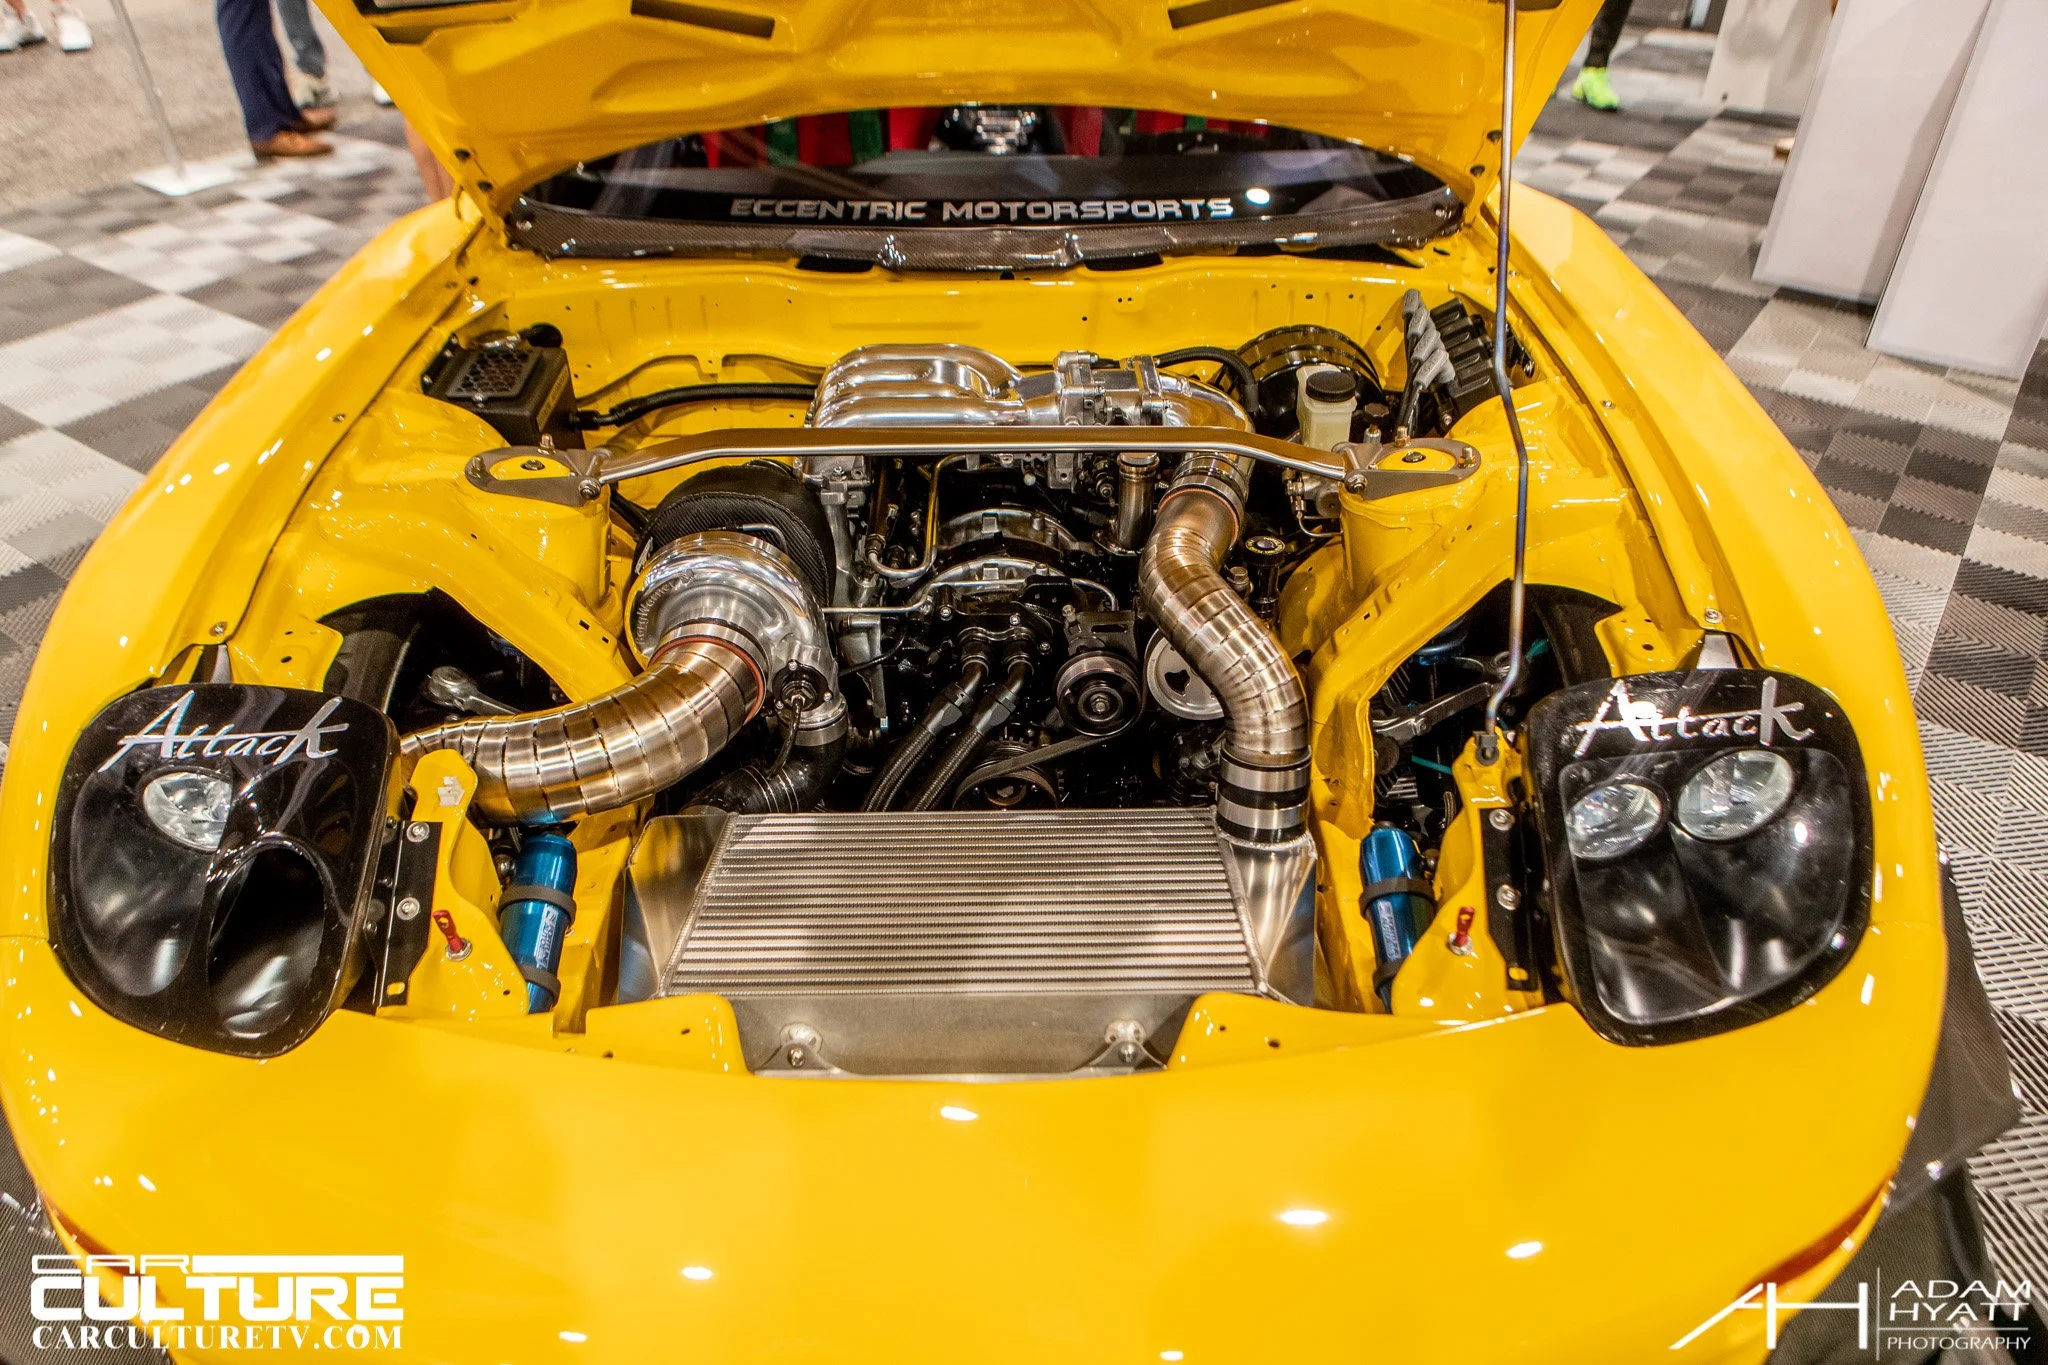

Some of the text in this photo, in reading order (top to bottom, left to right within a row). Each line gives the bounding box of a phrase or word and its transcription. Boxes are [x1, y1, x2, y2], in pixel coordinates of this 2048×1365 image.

[731, 198, 1235, 222] ECCENTRIC MOTORSPORTS
[97, 689, 350, 773] Attack
[1573, 676, 1816, 758] Attack
